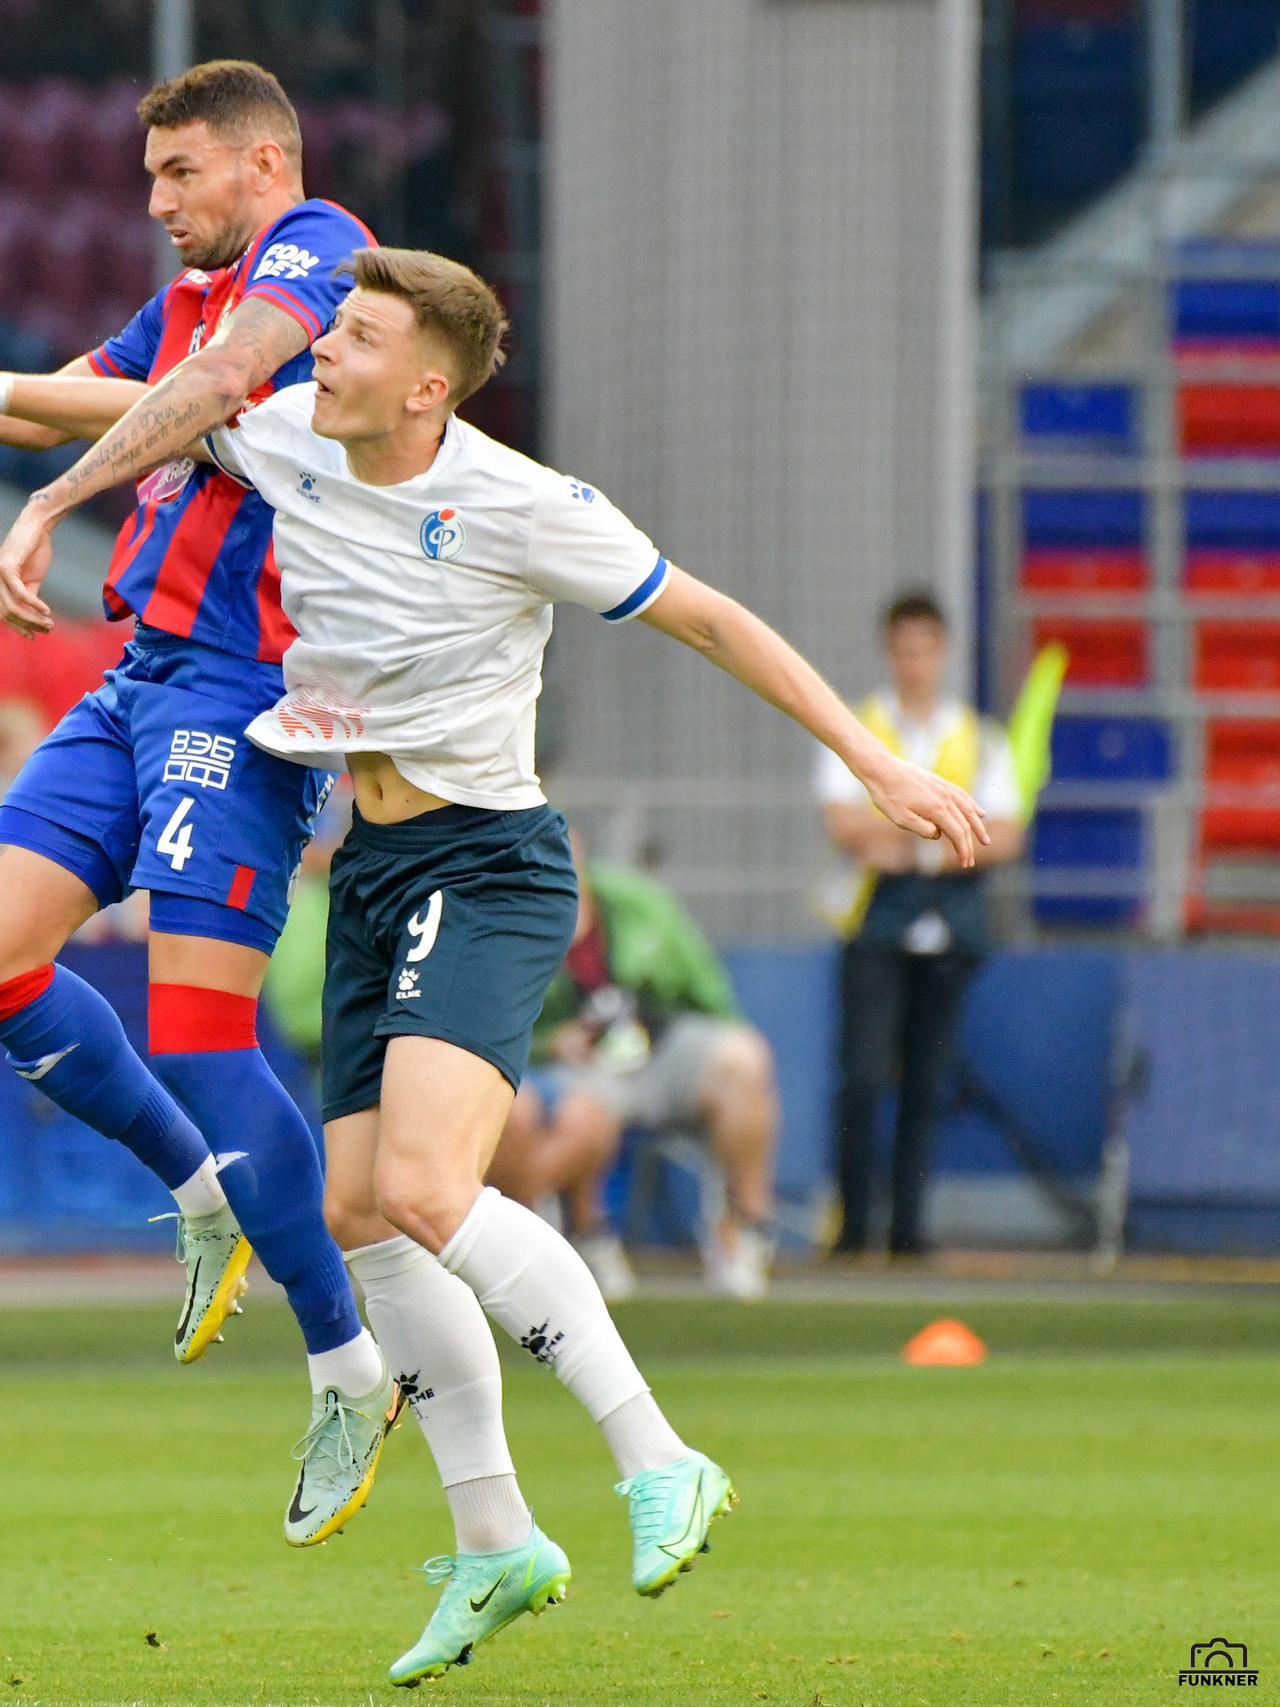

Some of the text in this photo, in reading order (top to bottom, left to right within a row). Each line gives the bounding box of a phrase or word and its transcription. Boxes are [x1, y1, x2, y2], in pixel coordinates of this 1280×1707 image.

[261, 243, 320, 270] FON
[253, 260, 309, 281] BET
[170, 729, 237, 762] ВЭБ
[156, 797, 195, 871] 4
[406, 889, 444, 963] 9
[395, 989, 422, 1000] ELME
[408, 1387, 436, 1406] LME
